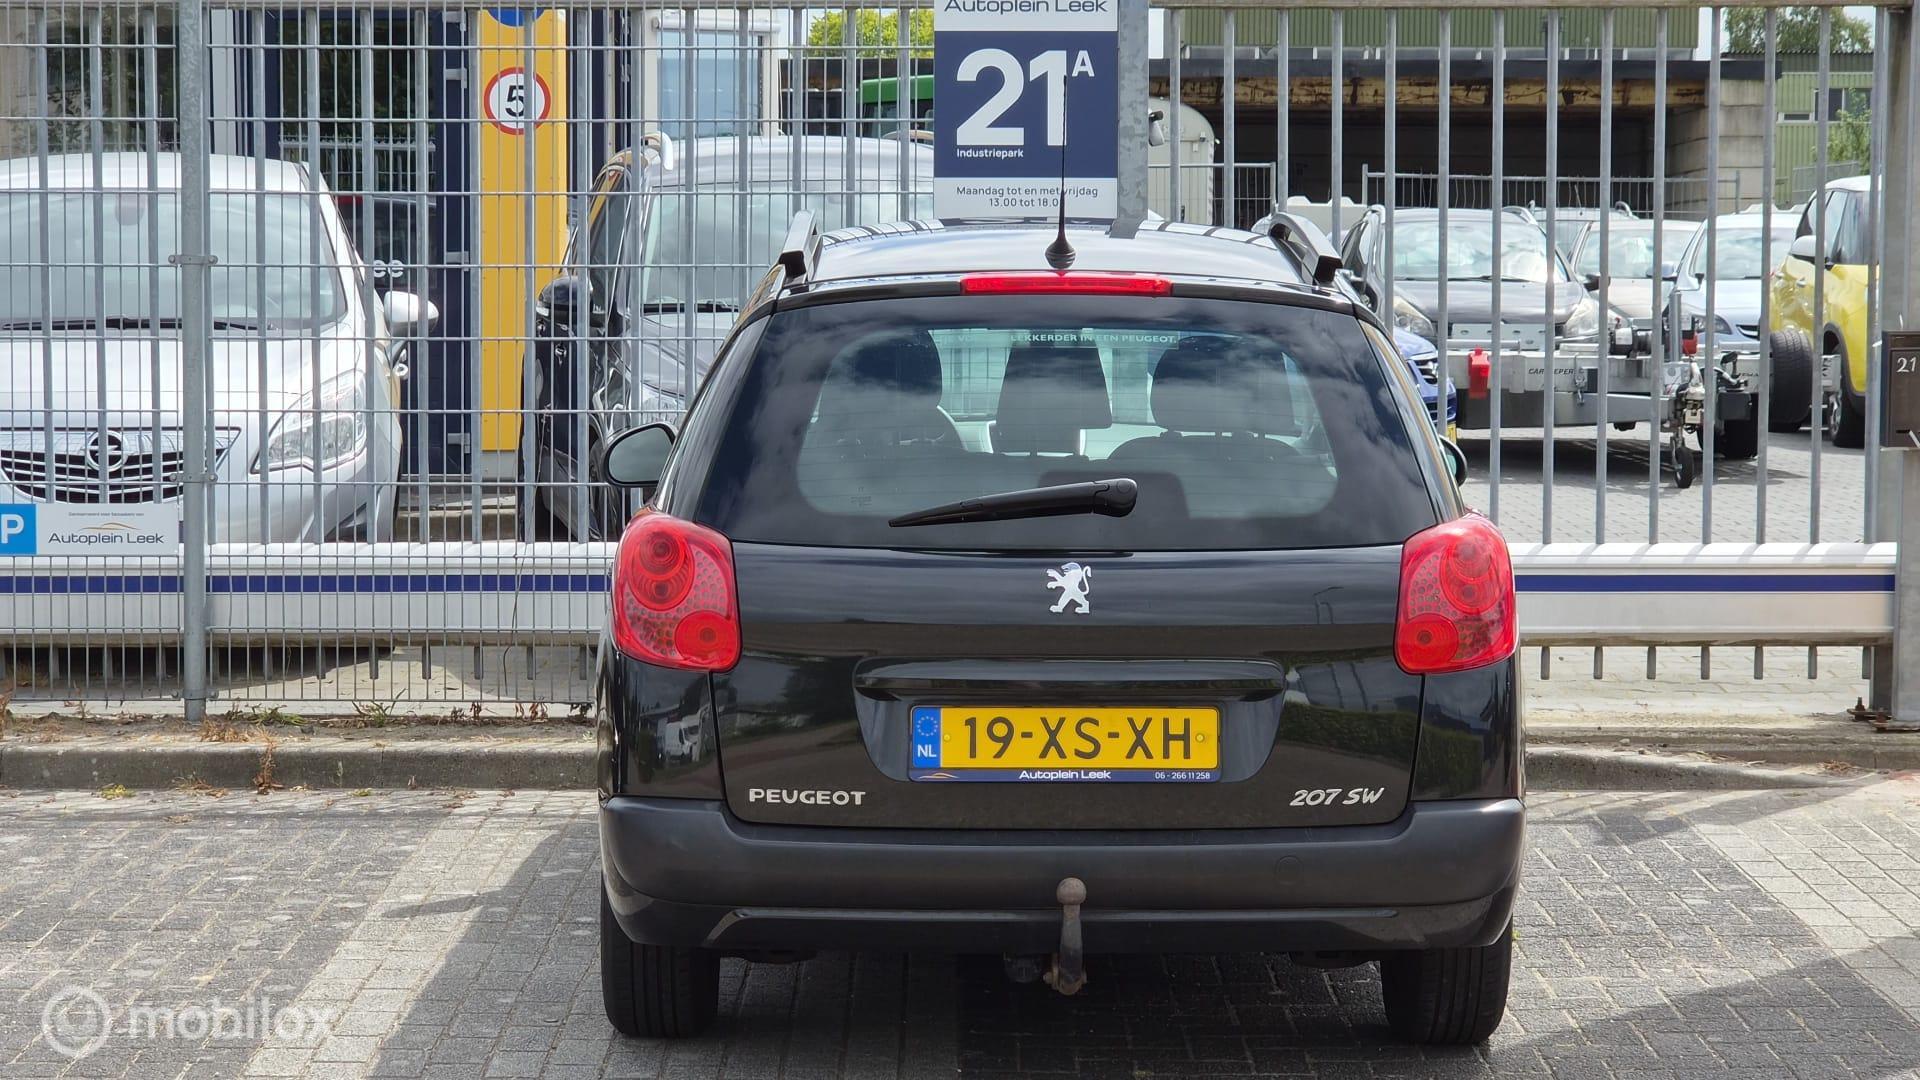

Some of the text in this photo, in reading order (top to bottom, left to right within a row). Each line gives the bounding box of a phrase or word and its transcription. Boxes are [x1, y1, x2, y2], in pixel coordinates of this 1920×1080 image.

[944, 0, 1107, 15] Autoplein Leek
[505, 85, 525, 117] 5
[957, 48, 1067, 146] 21
[956, 148, 1024, 160] Industriepark
[956, 186, 1004, 197] Maandag
[1006, 186, 1022, 195] tot
[1024, 187, 1038, 195] en
[1039, 186, 1060, 195] met
[989, 197, 1061, 207] 13.00 tot 18.0
[1896, 356, 1917, 373] 21
[0, 513, 25, 544] P
[48, 532, 164, 546] Autoplein Leek
[964, 716, 1191, 760] 19-XS-XH
[917, 744, 937, 758] NL
[1019, 770, 1111, 781] Autoplein Leek
[748, 788, 866, 806] PEUGEOT
[1289, 787, 1385, 807] 207 SW
